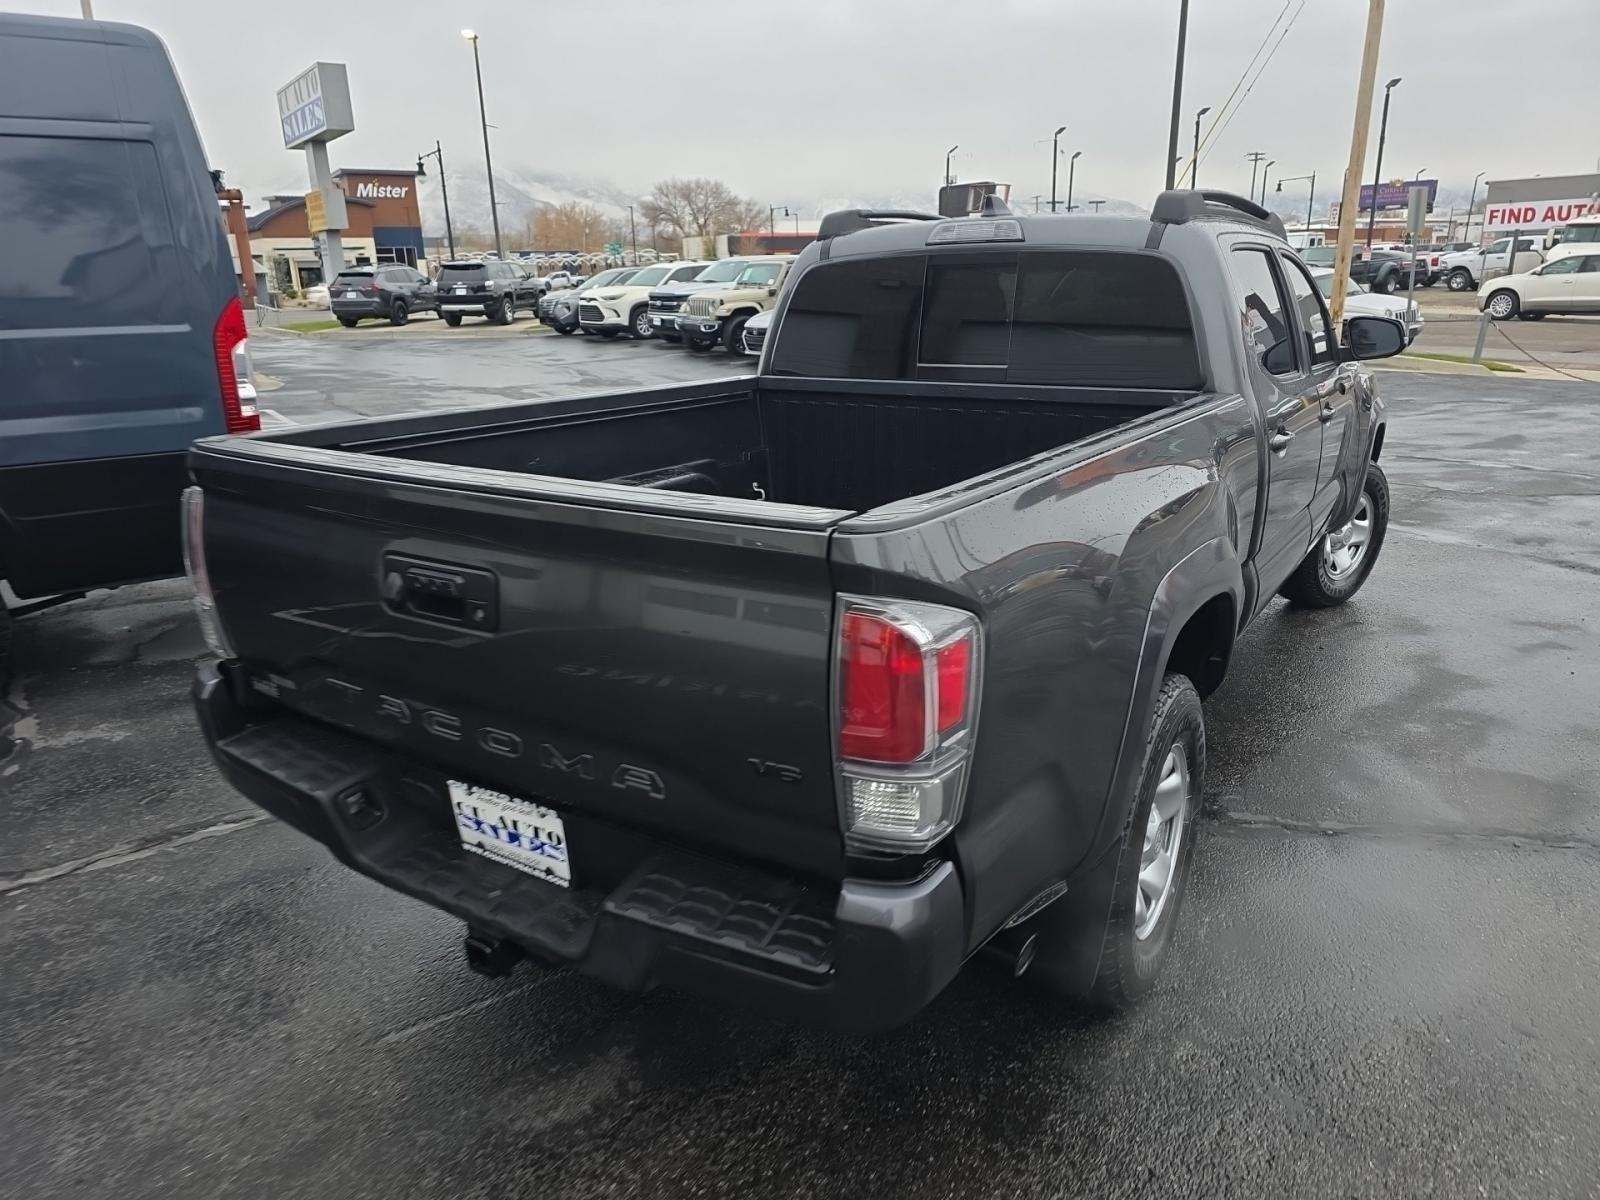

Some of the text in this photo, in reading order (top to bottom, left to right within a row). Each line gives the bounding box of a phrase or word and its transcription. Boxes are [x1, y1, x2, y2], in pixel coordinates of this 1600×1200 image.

[293, 70, 319, 106] AUTO
[283, 100, 326, 139] SALES
[356, 180, 408, 198] Mister
[1488, 207, 1537, 225] FIND
[325, 676, 667, 801] TACOMA
[746, 757, 804, 783] V6
[456, 812, 567, 862] SALES
[496, 815, 563, 847] AUTO
